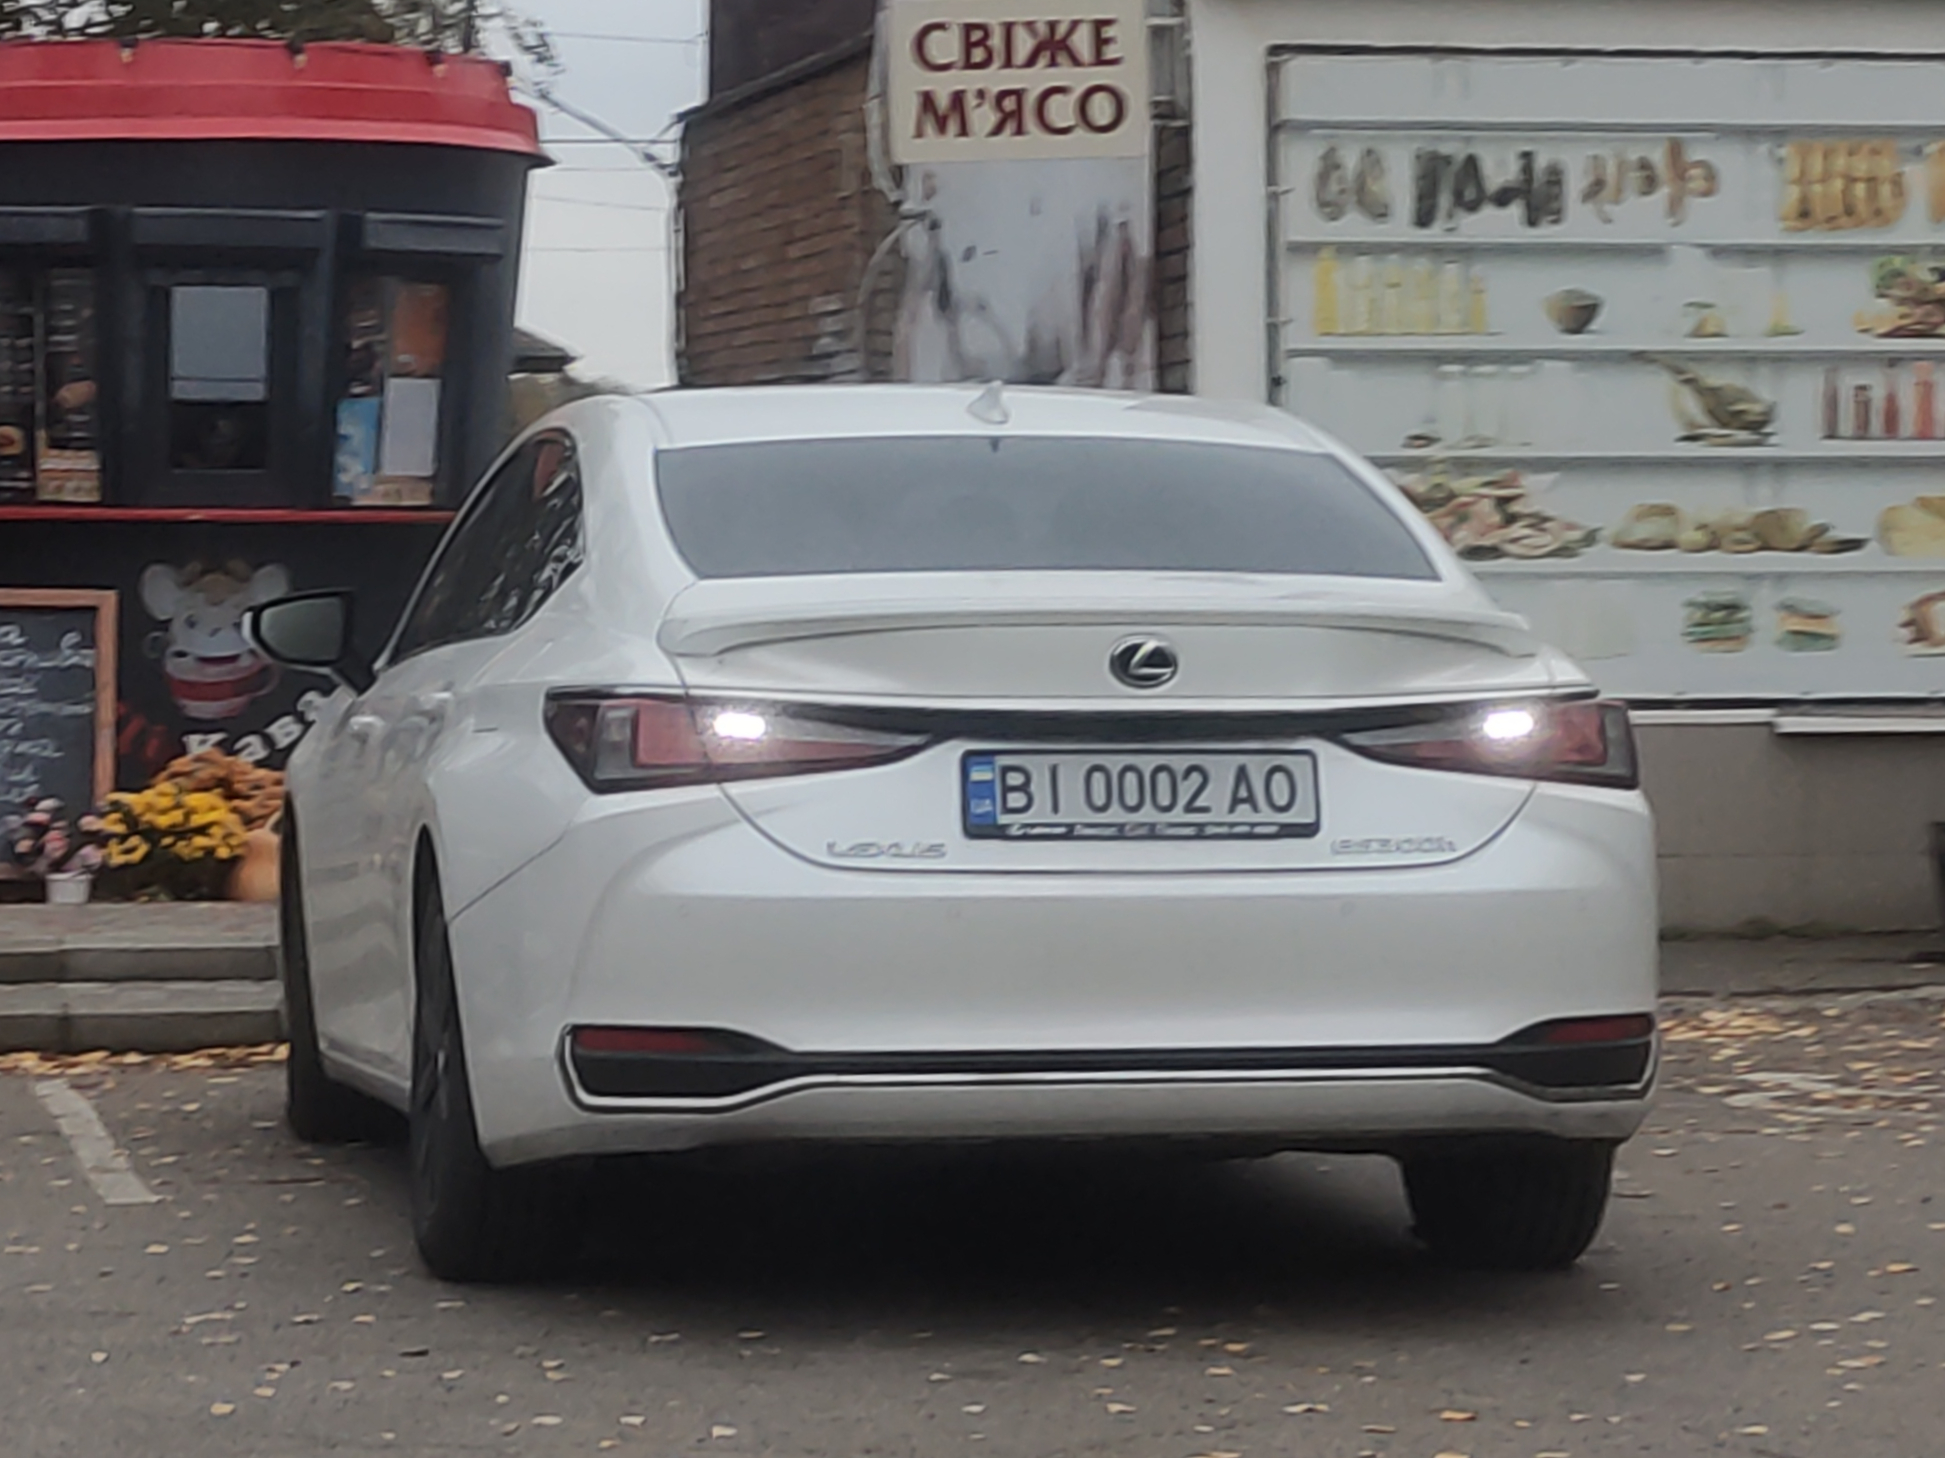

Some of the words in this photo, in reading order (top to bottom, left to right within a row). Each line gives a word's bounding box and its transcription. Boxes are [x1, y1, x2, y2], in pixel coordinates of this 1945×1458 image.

[911, 18, 1125, 72] СВІЖЕ
[999, 764, 1061, 816] BI
[1084, 764, 1212, 815] 0002
[1227, 763, 1298, 815] AO
